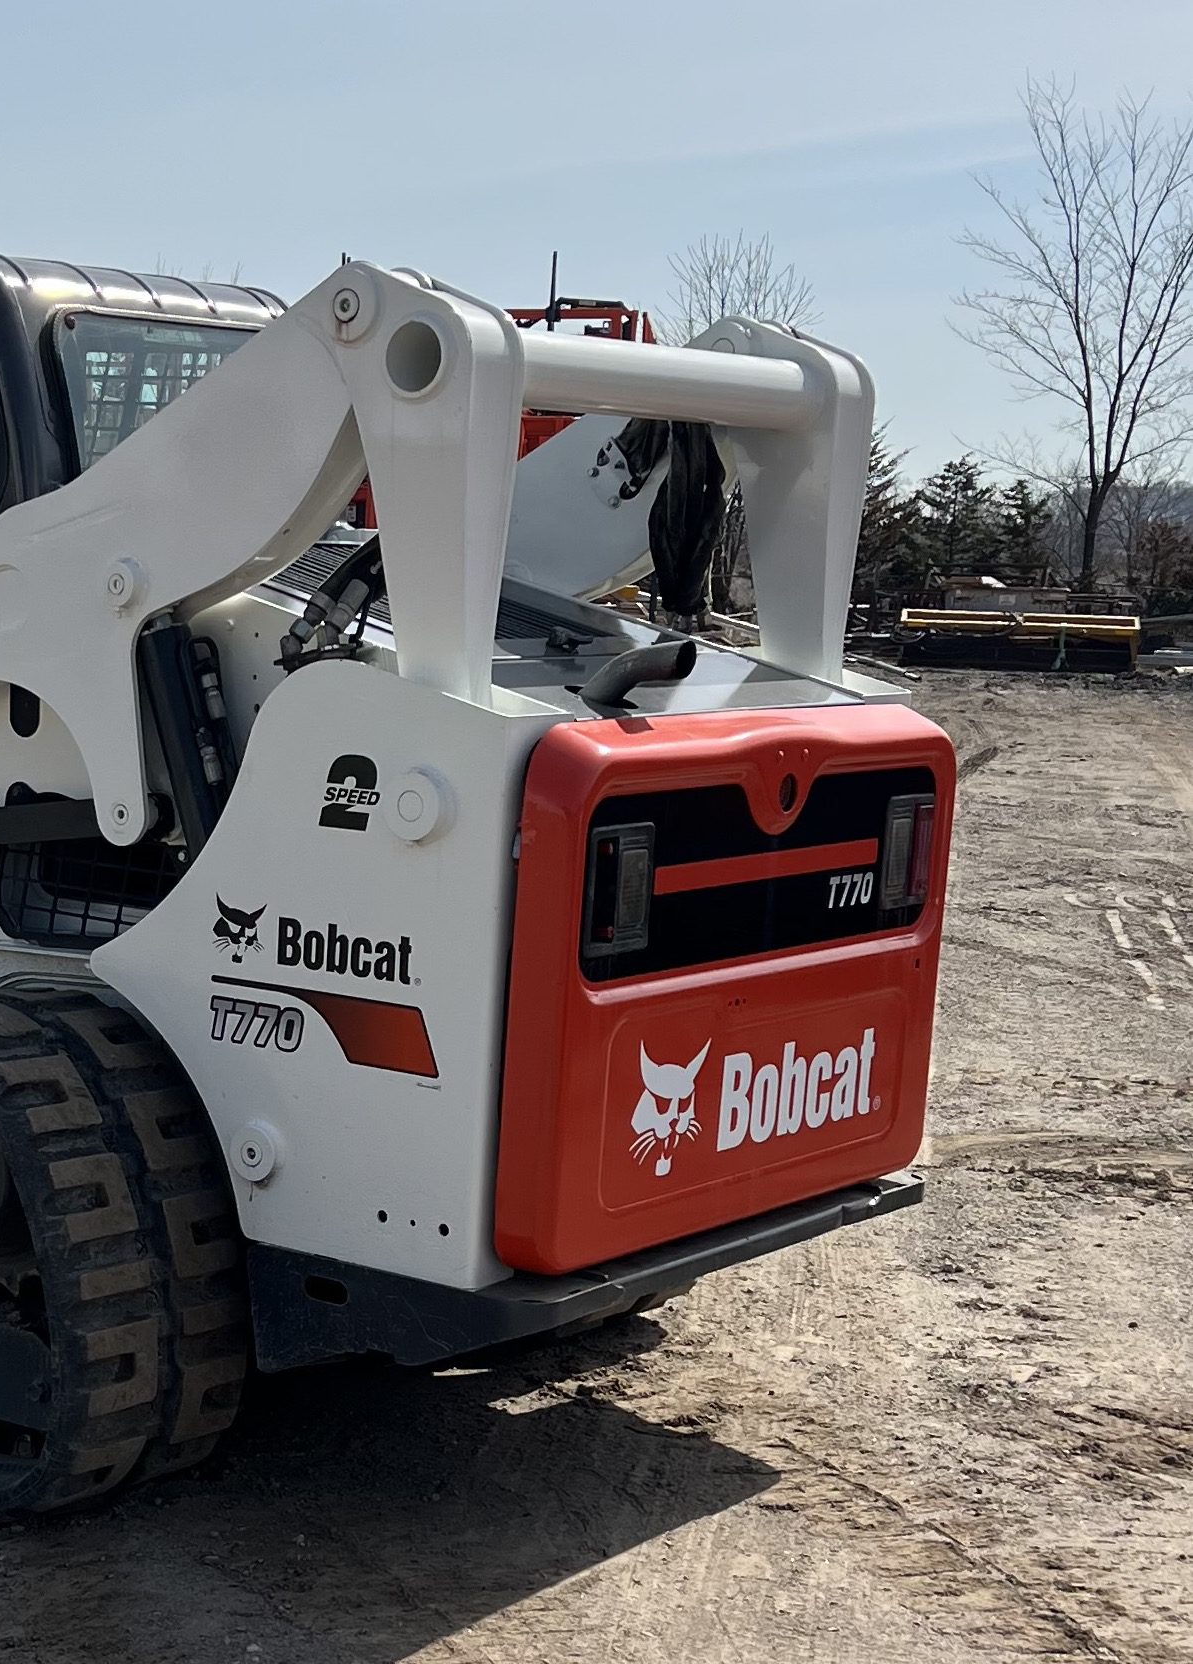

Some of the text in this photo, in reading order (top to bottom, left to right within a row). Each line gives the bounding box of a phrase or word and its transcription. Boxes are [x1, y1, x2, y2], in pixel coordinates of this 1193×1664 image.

[318, 754, 378, 832] 2
[323, 786, 381, 806] SPEED
[828, 871, 874, 909] T770
[276, 916, 412, 986] Bobcat
[209, 994, 305, 1053] T770
[716, 1027, 876, 1152] Bobcat
